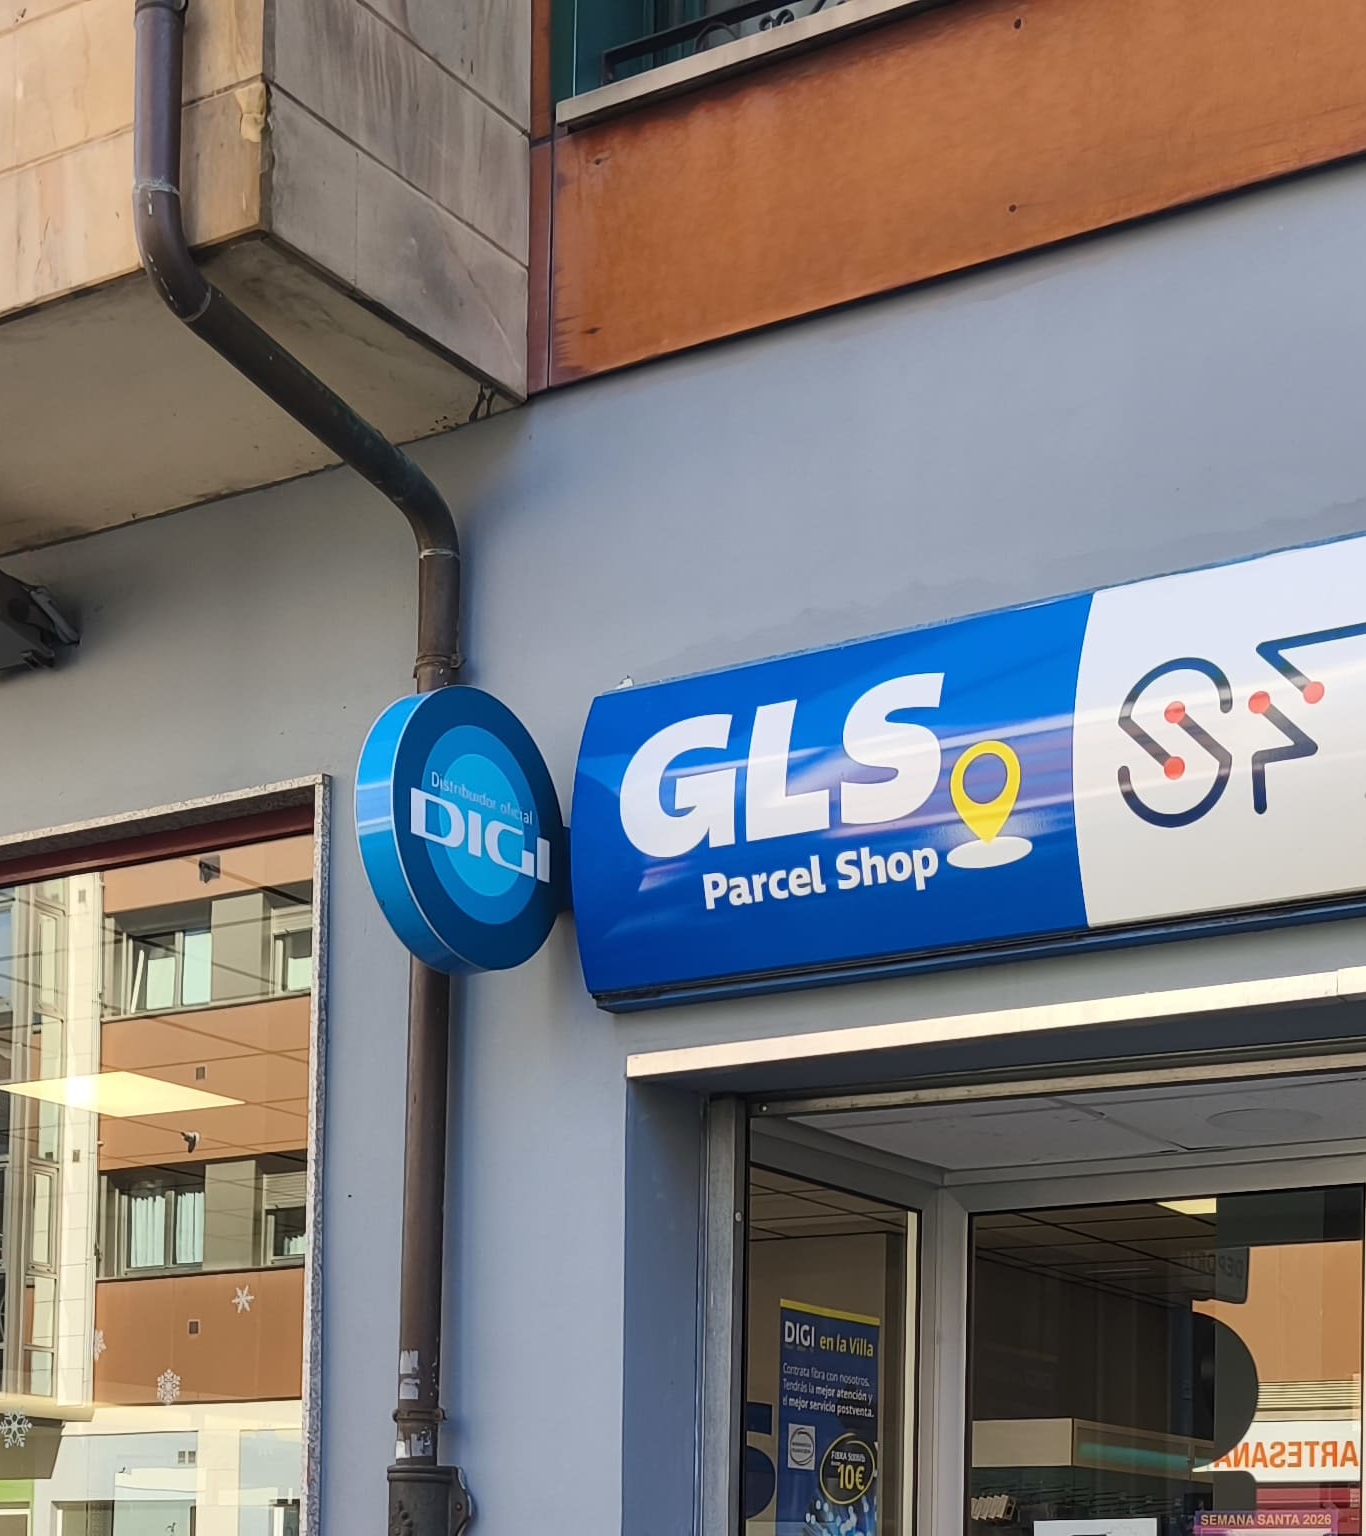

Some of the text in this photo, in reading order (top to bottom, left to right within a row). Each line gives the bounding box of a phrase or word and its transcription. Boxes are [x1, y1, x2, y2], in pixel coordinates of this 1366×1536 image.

[620, 671, 945, 859] GLS
[431, 770, 533, 826] Distribuidor oficial
[410, 787, 551, 884] DIGI
[702, 845, 940, 911] Parcel Shop
[785, 1320, 815, 1348] DIGI
[819, 1335, 834, 1350] en
[836, 1334, 847, 1353] la
[849, 1337, 875, 1358] Villa
[782, 1362, 810, 1378] Contrata
[810, 1366, 826, 1381] fibra
[826, 1373, 838, 1383] con
[782, 1378, 808, 1393] Tendrás
[815, 1386, 836, 1399] mejor
[836, 1386, 868, 1402] atención
[788, 1396, 809, 1412] mejor
[809, 1399, 836, 1413] servicio
[836, 1403, 875, 1418] postventa.
[837, 1464, 866, 1491] 10€
[1200, 1514, 1332, 1526] SEMANA SANTA 2026
